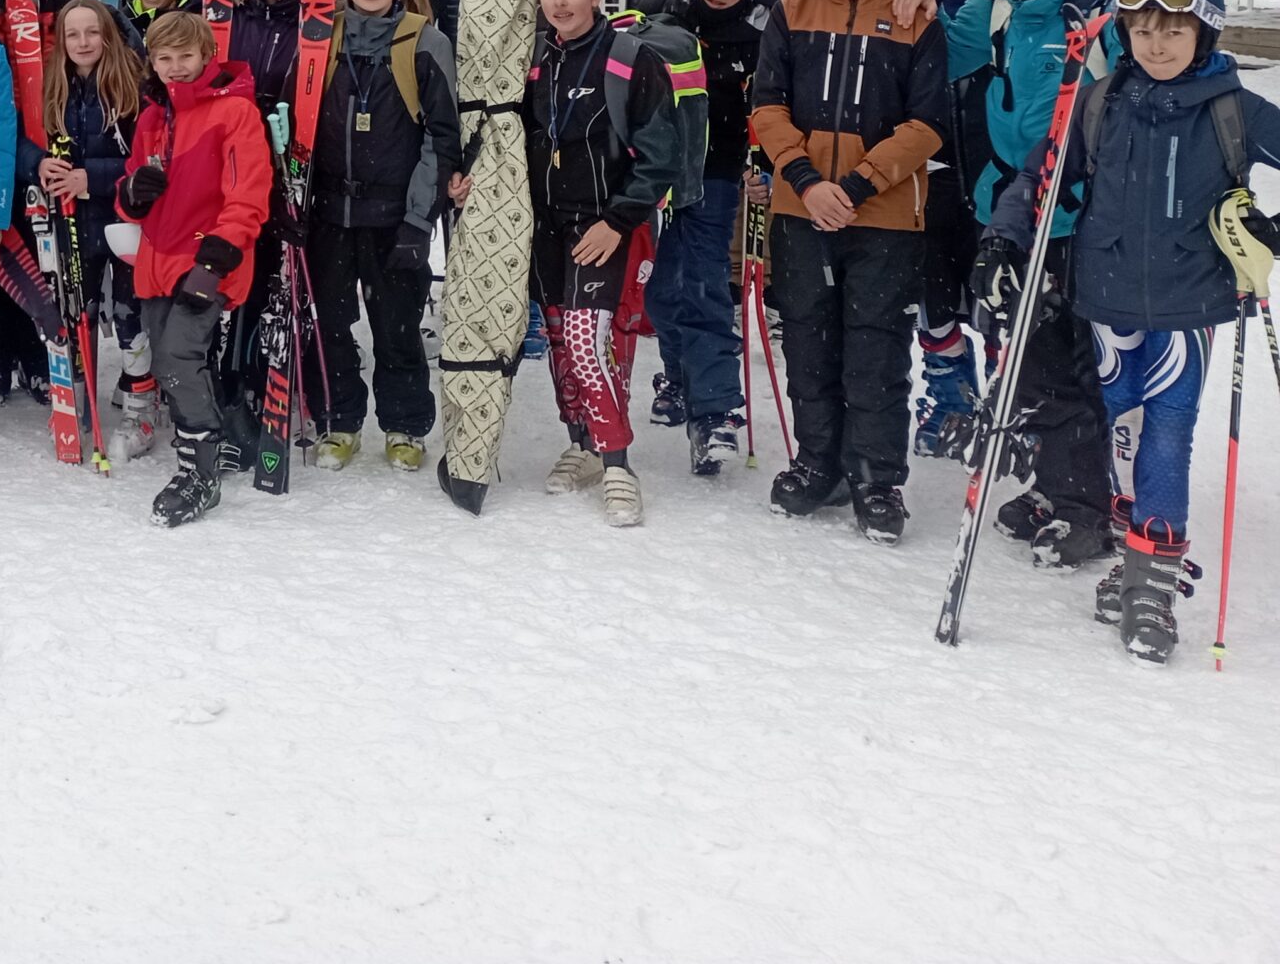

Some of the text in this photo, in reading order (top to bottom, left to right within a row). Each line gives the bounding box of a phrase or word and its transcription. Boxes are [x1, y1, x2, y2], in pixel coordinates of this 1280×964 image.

[756, 205, 765, 241] LEKI
[1224, 217, 1248, 258] LEKI
[1232, 351, 1244, 394] LEKI
[1115, 425, 1132, 462] FILA
